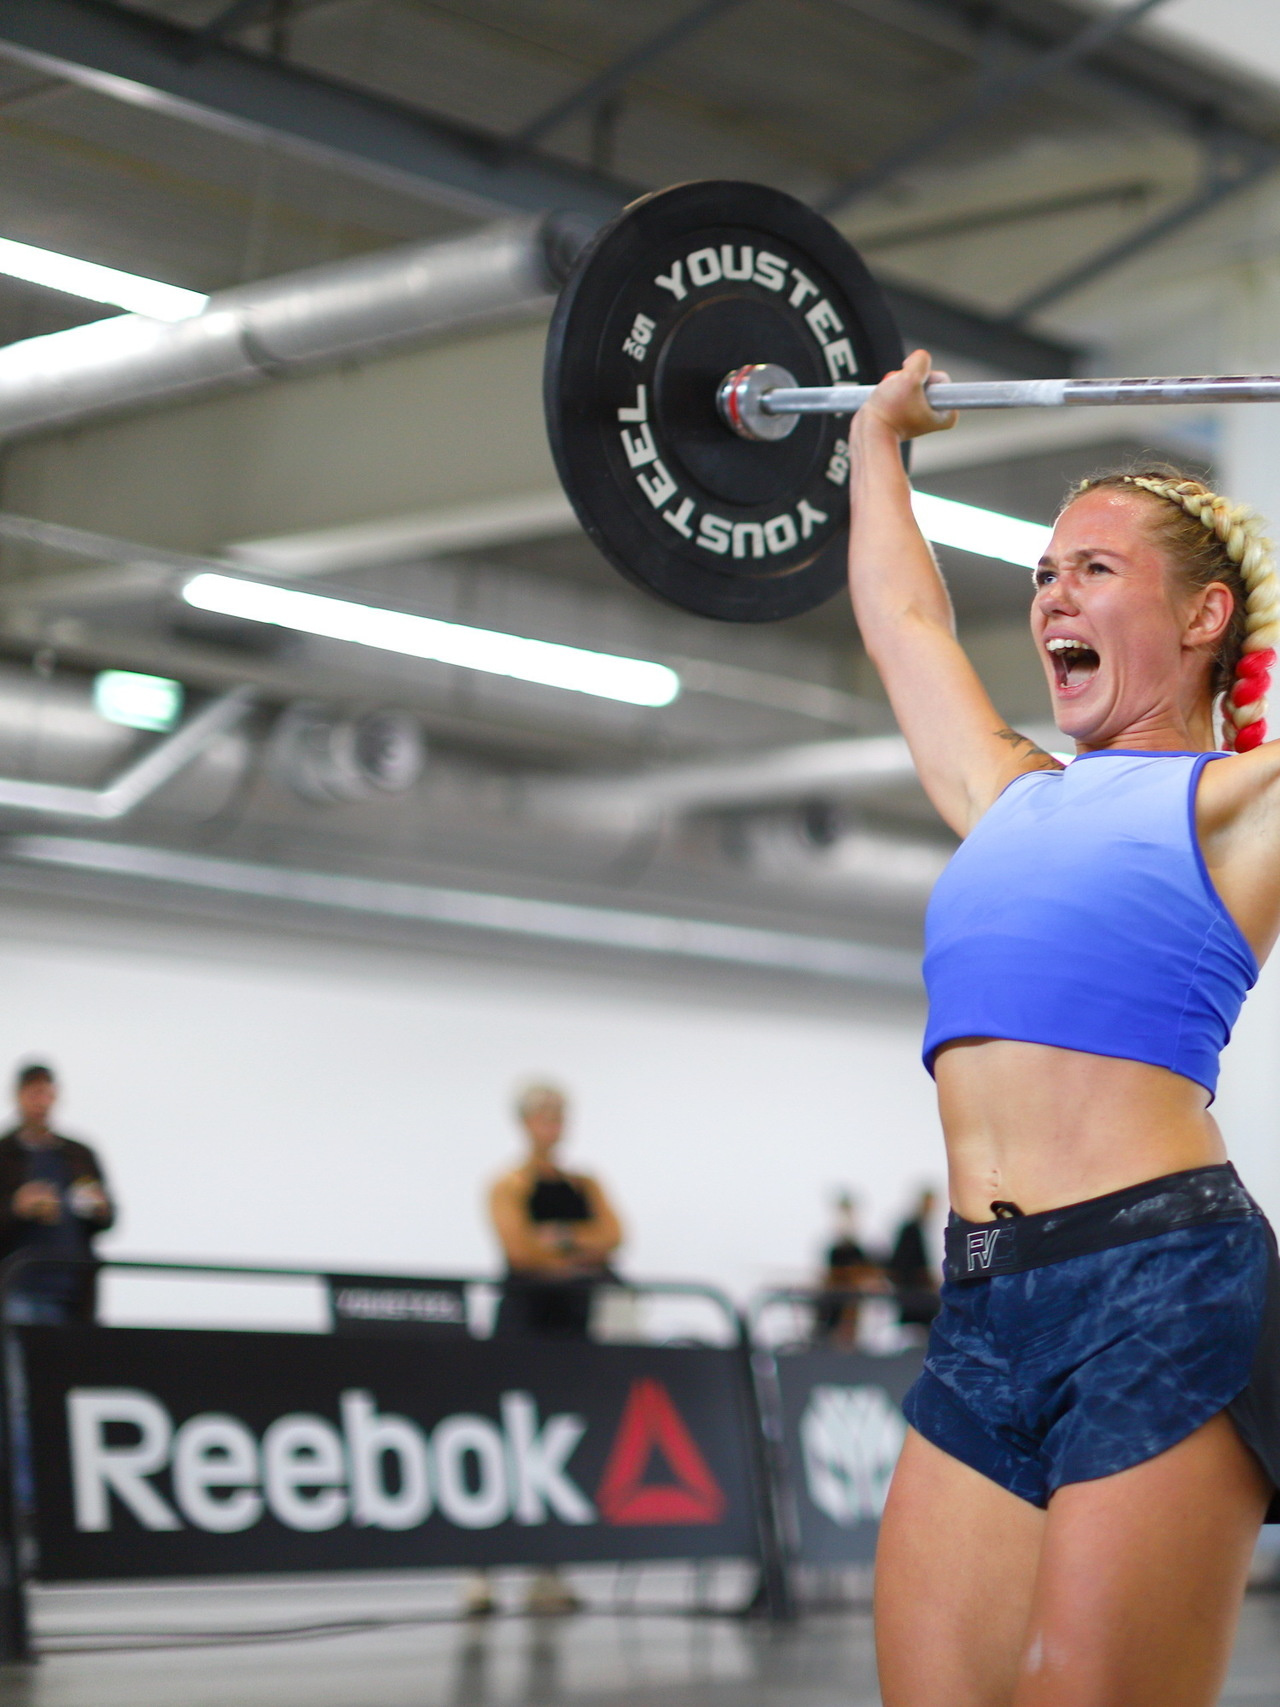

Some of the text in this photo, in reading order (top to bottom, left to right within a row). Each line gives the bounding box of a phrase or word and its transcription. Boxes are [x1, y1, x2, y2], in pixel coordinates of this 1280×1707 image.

[621, 337, 647, 363] KG
[630, 312, 657, 346] 5
[617, 383, 828, 559] YOUSTEEL
[66, 1386, 597, 1534] Reebok
